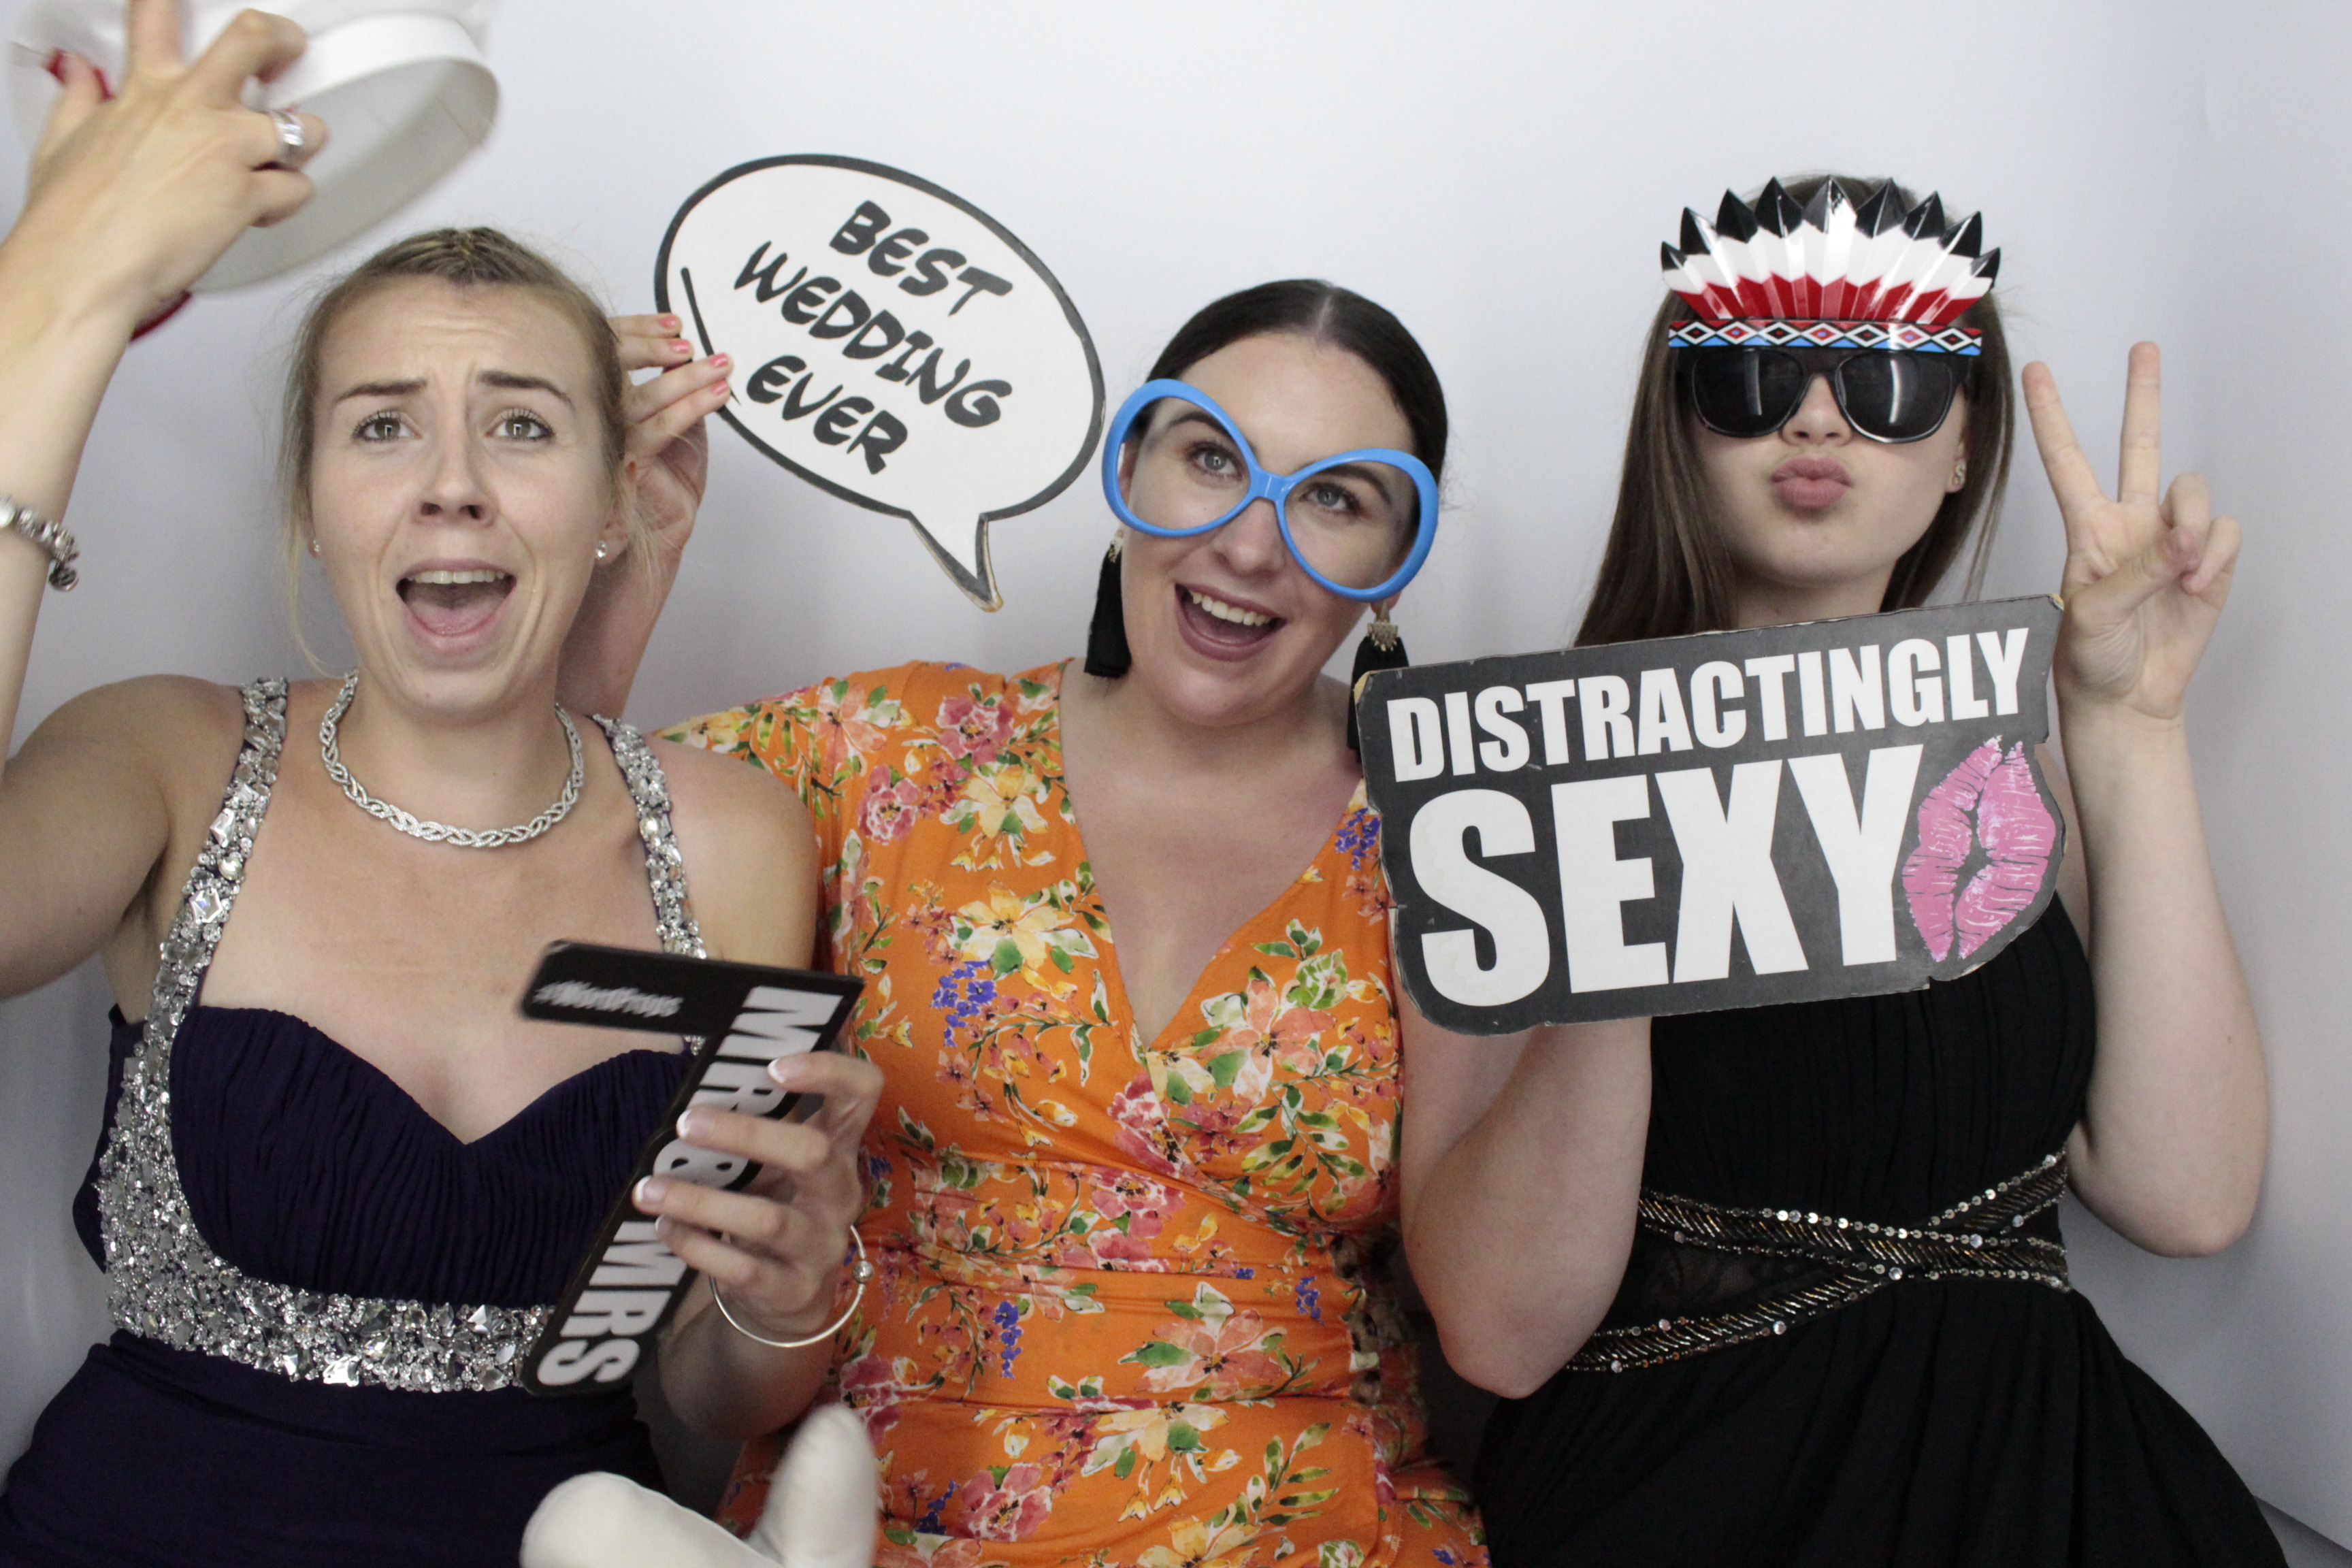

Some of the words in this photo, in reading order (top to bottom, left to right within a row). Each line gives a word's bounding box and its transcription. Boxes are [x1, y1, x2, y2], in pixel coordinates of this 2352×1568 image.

[734, 240, 1012, 427] WEDDING
[829, 200, 1013, 316] BEST
[746, 355, 907, 474] EVER
[1386, 627, 2028, 782] DISTRACTINGLY
[1409, 744, 1923, 1007] SEXY
[537, 1221, 687, 1386] MRS
